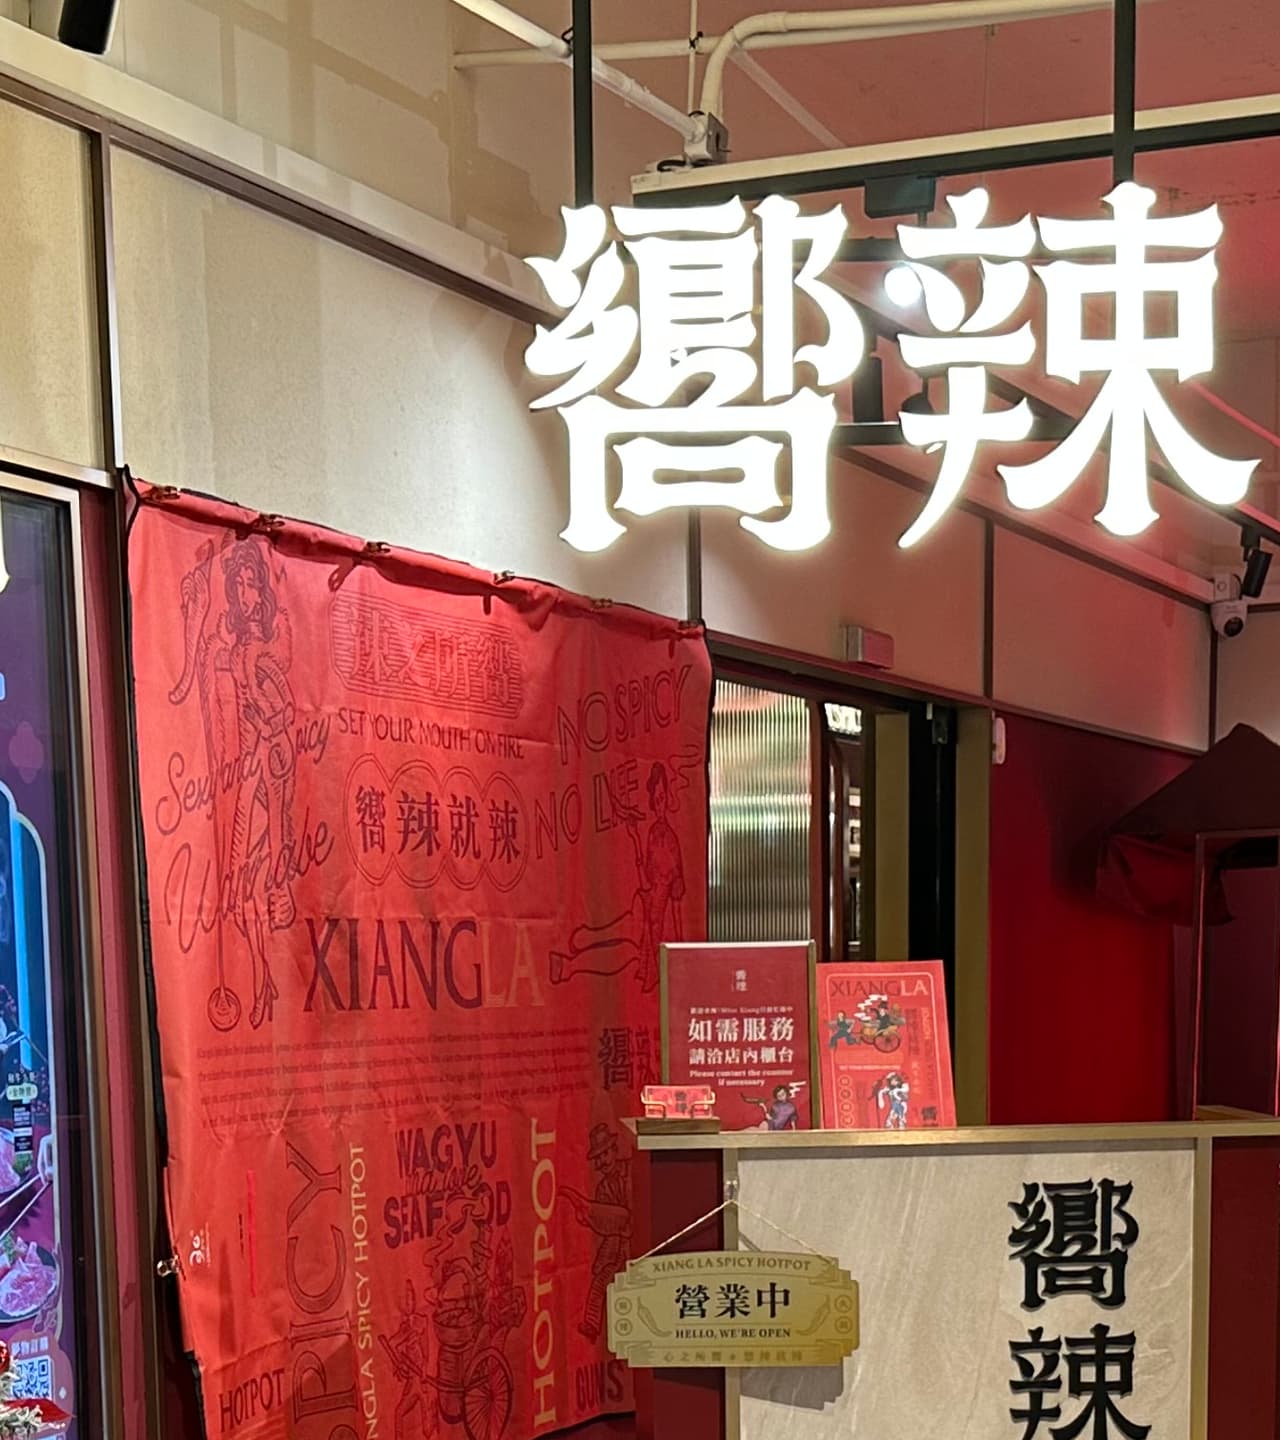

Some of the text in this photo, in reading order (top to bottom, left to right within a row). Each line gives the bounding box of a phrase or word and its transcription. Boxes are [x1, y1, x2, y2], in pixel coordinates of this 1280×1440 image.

[338, 706, 365, 735] SET
[614, 664, 692, 744] SPICY
[688, 1017, 795, 1043] 如需服務
[688, 1046, 795, 1065] 請洽店內櫃台
[395, 1120, 497, 1180] WAGYU
[349, 1143, 368, 1263] HOTPOT
[531, 1117, 556, 1430] HOTPOT
[652, 1256, 812, 1273] XIANG LA SPICY HOTPOT
[354, 1271, 372, 1350] SPICY
[675, 1282, 792, 1319] 營業中
[675, 1327, 792, 1339] HELLO, WE'RE OPEN
[220, 1368, 286, 1433] HOTPOT
